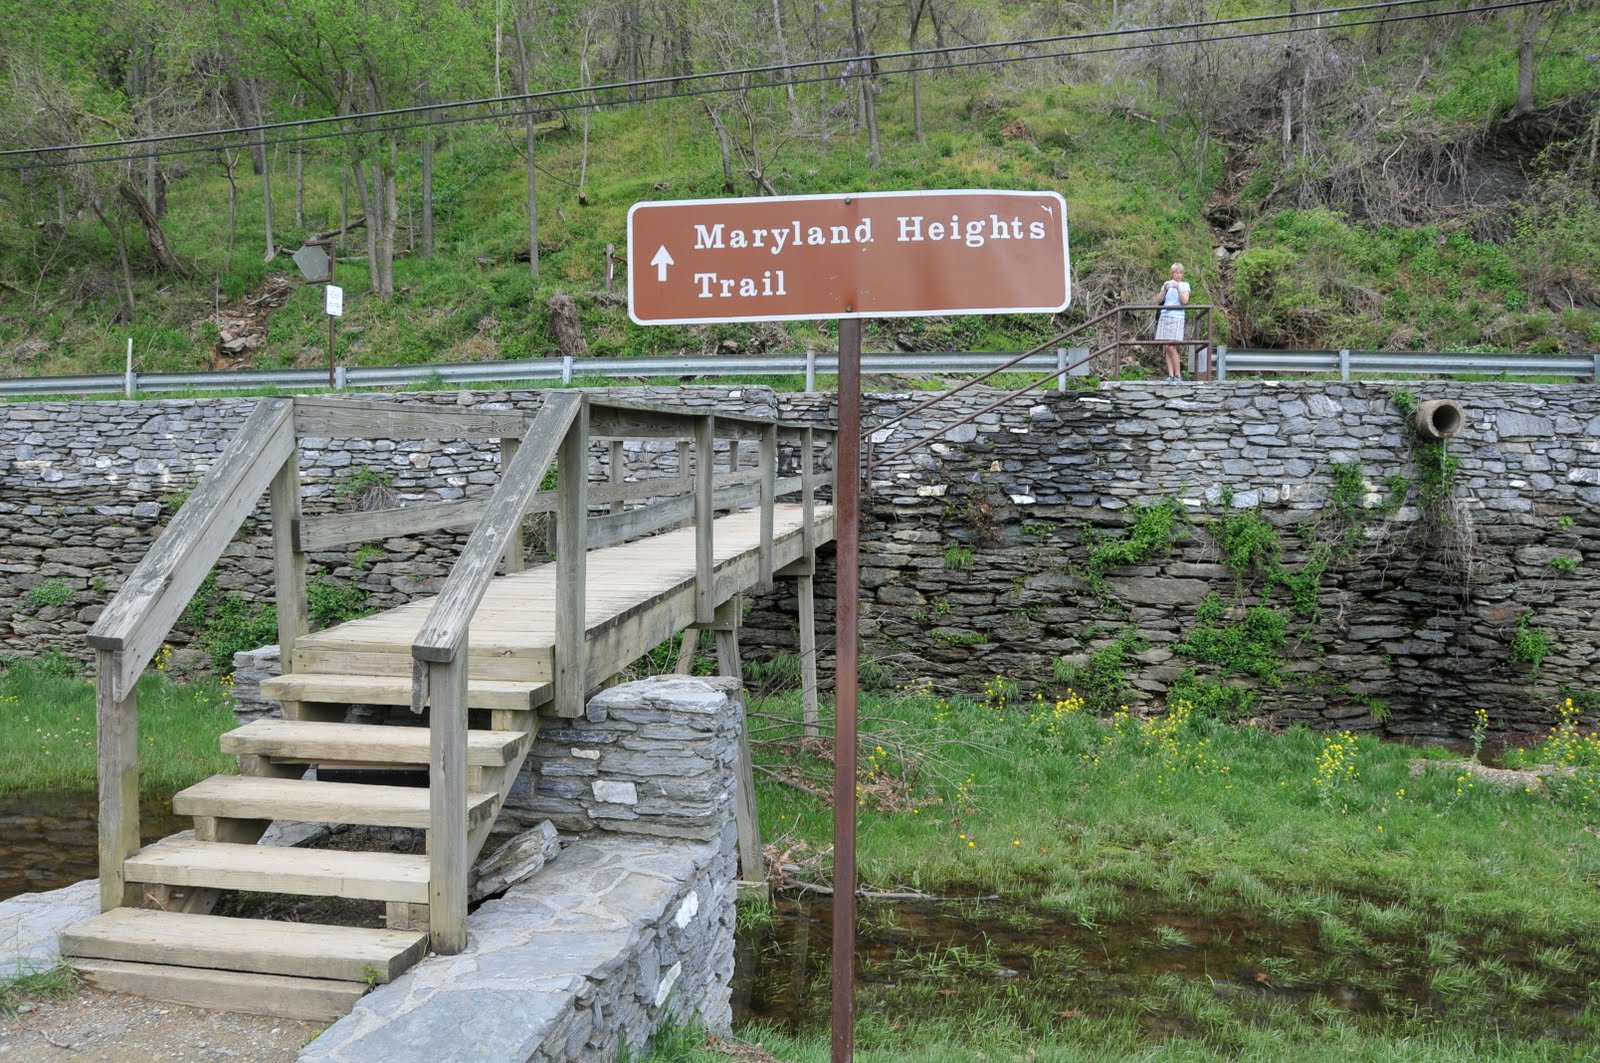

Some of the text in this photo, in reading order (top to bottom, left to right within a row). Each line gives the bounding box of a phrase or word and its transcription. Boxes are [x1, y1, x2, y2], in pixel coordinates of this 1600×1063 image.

[694, 214, 1046, 254] Maryland Heights
[694, 270, 787, 298] Trail
